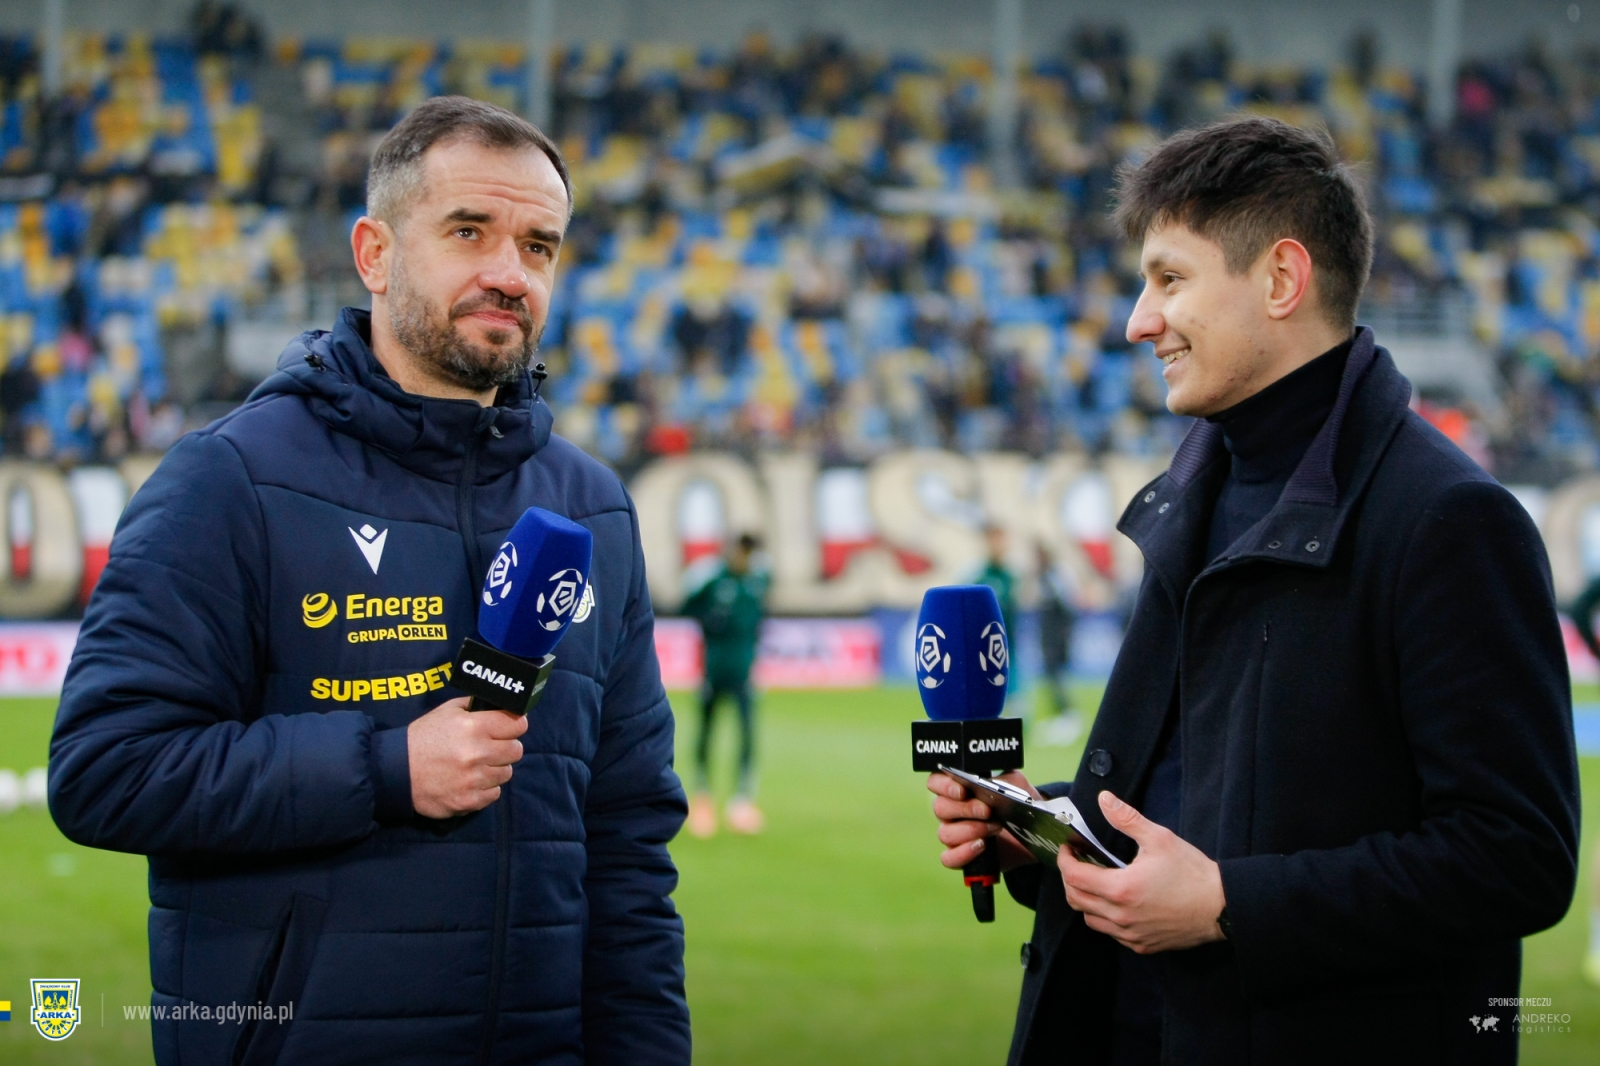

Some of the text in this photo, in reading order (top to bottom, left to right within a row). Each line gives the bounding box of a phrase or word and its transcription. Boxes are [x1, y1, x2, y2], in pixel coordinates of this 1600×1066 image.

[346, 593, 443, 622] Energa
[347, 626, 444, 643] GRUPA ORLEN
[310, 662, 453, 702] SUPERBET
[462, 660, 525, 694] CANAL+
[916, 740, 959, 753] CANAL+
[967, 737, 1019, 753] CANAL+
